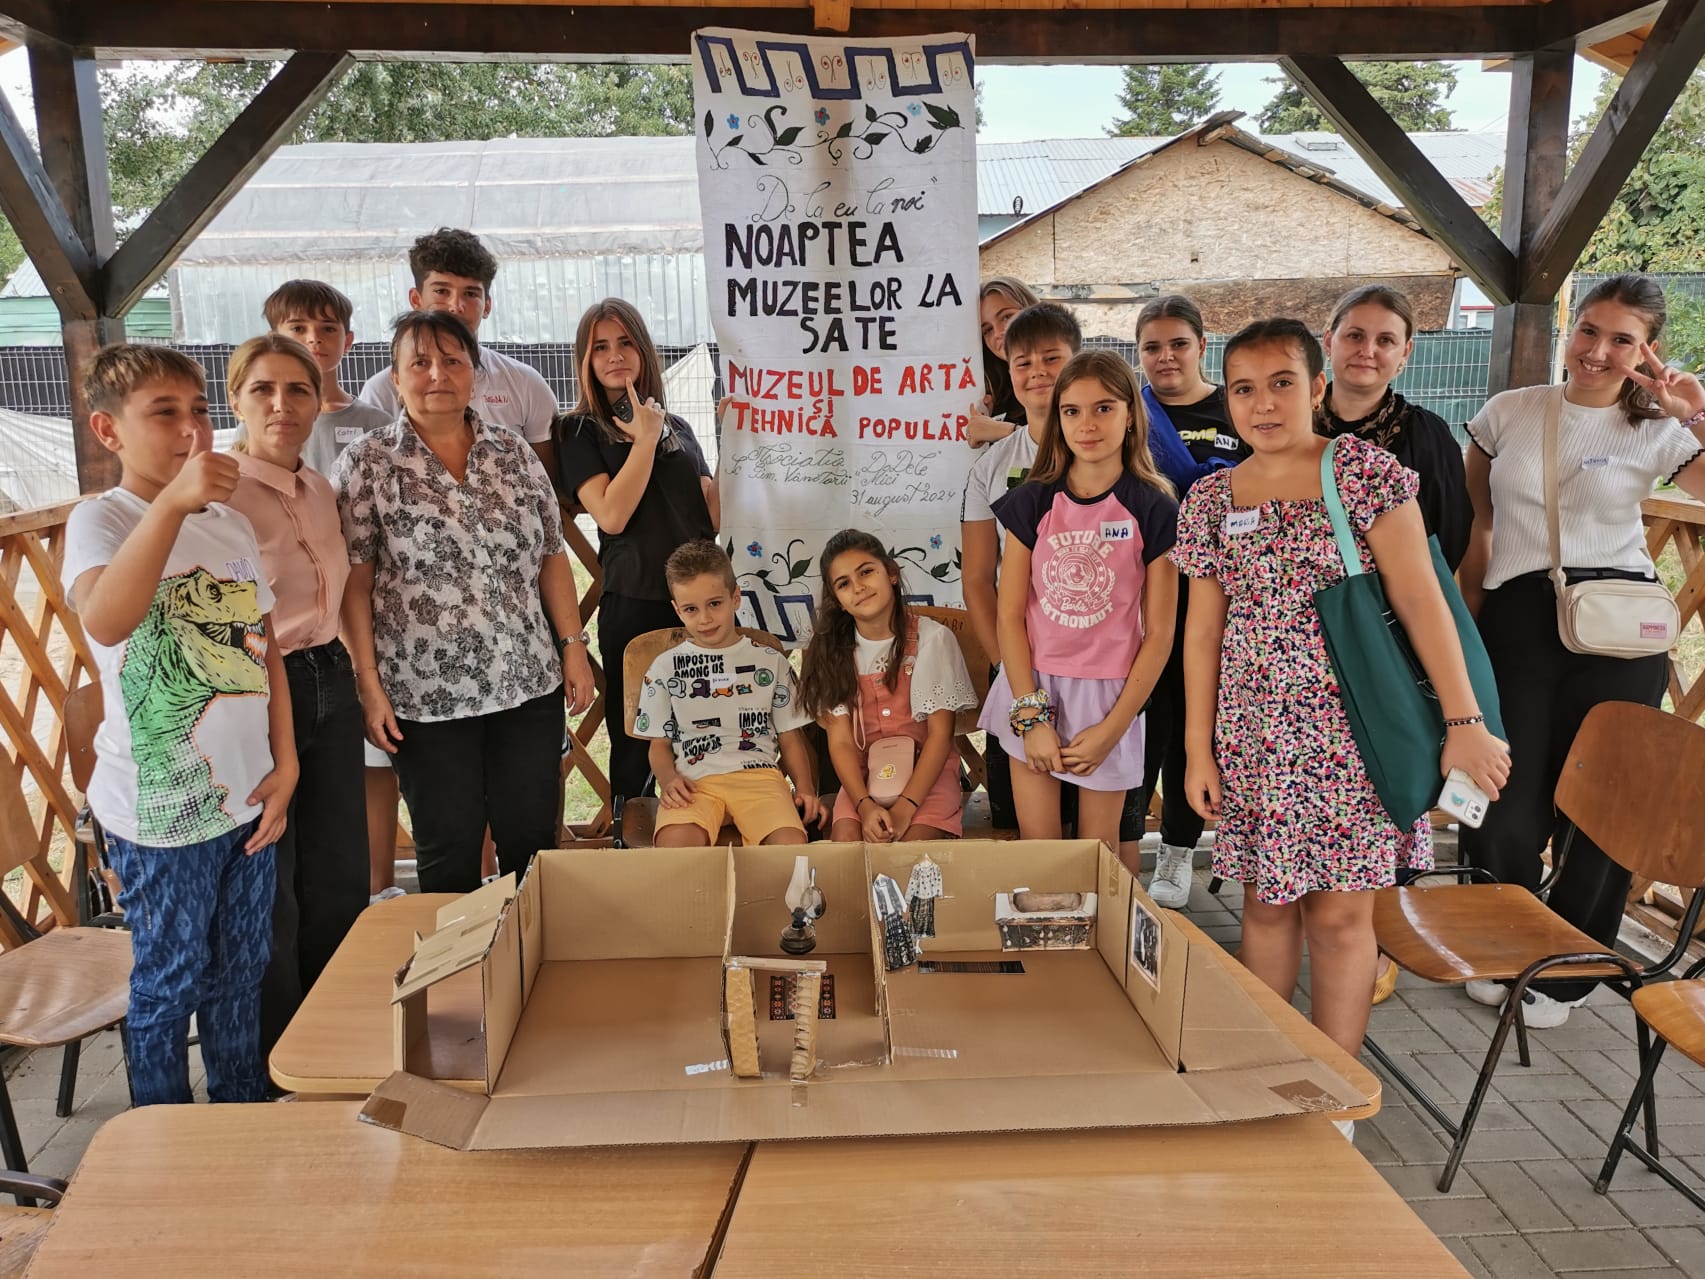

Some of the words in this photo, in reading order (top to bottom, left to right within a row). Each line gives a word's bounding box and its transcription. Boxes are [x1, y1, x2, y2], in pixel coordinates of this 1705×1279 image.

[833, 202, 858, 217] eu
[724, 221, 904, 269] NOAPTEA
[727, 277, 903, 317] MUZEELOR
[918, 272, 963, 307] LA
[800, 316, 898, 354] SATE
[728, 359, 845, 400] MUZEUL
[852, 365, 883, 397] DE
[898, 356, 977, 396] ARTĂ
[1215, 436, 1237, 448] ANA
[850, 489, 866, 505] 31
[865, 482, 931, 517] august
[919, 489, 956, 503] 2024
[1047, 530, 1115, 559] FUTURE
[1105, 527, 1129, 538] ANA
[1039, 597, 1114, 629] ASTRONAUT
[674, 665, 710, 678] AMONG
[712, 662, 724, 674] US
